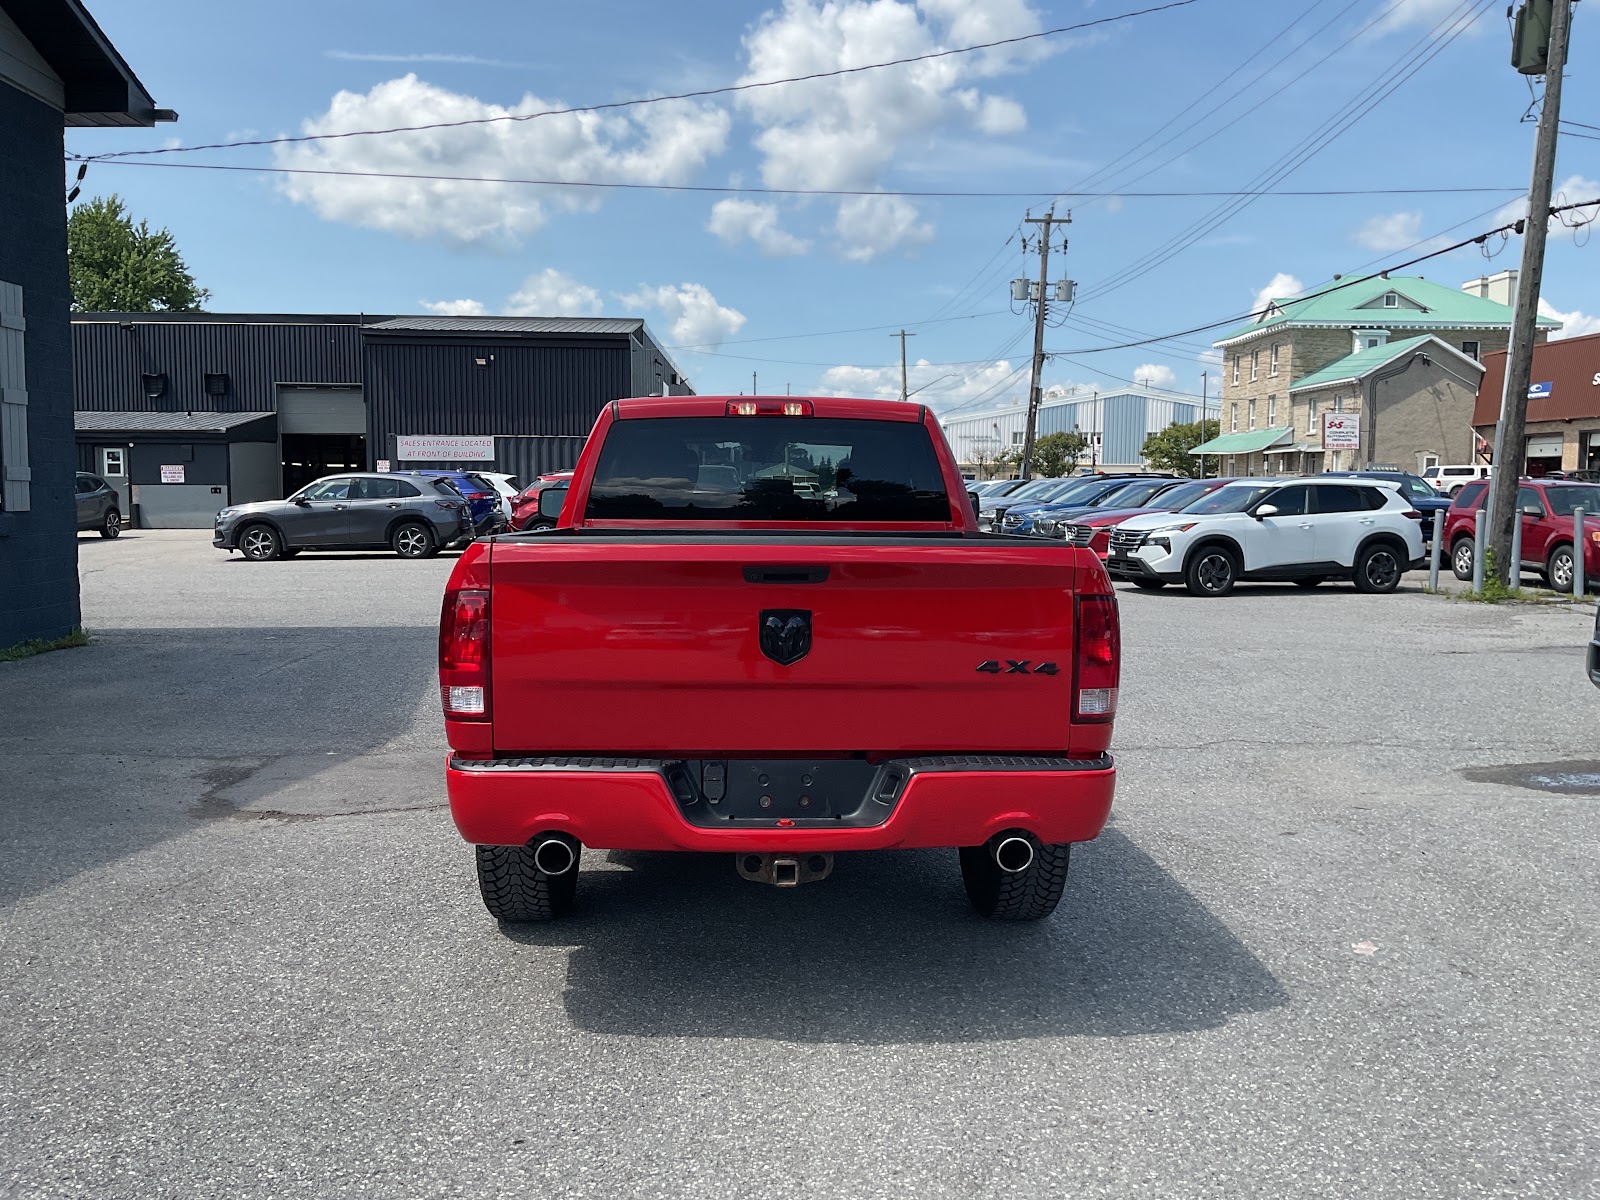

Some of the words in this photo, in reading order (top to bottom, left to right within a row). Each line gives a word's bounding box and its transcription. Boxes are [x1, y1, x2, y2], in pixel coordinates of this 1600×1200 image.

[417, 450, 441, 458] FRONT
[442, 450, 452, 458] OF
[453, 450, 486, 458] BUILDING
[976, 660, 1061, 676] 4X4
